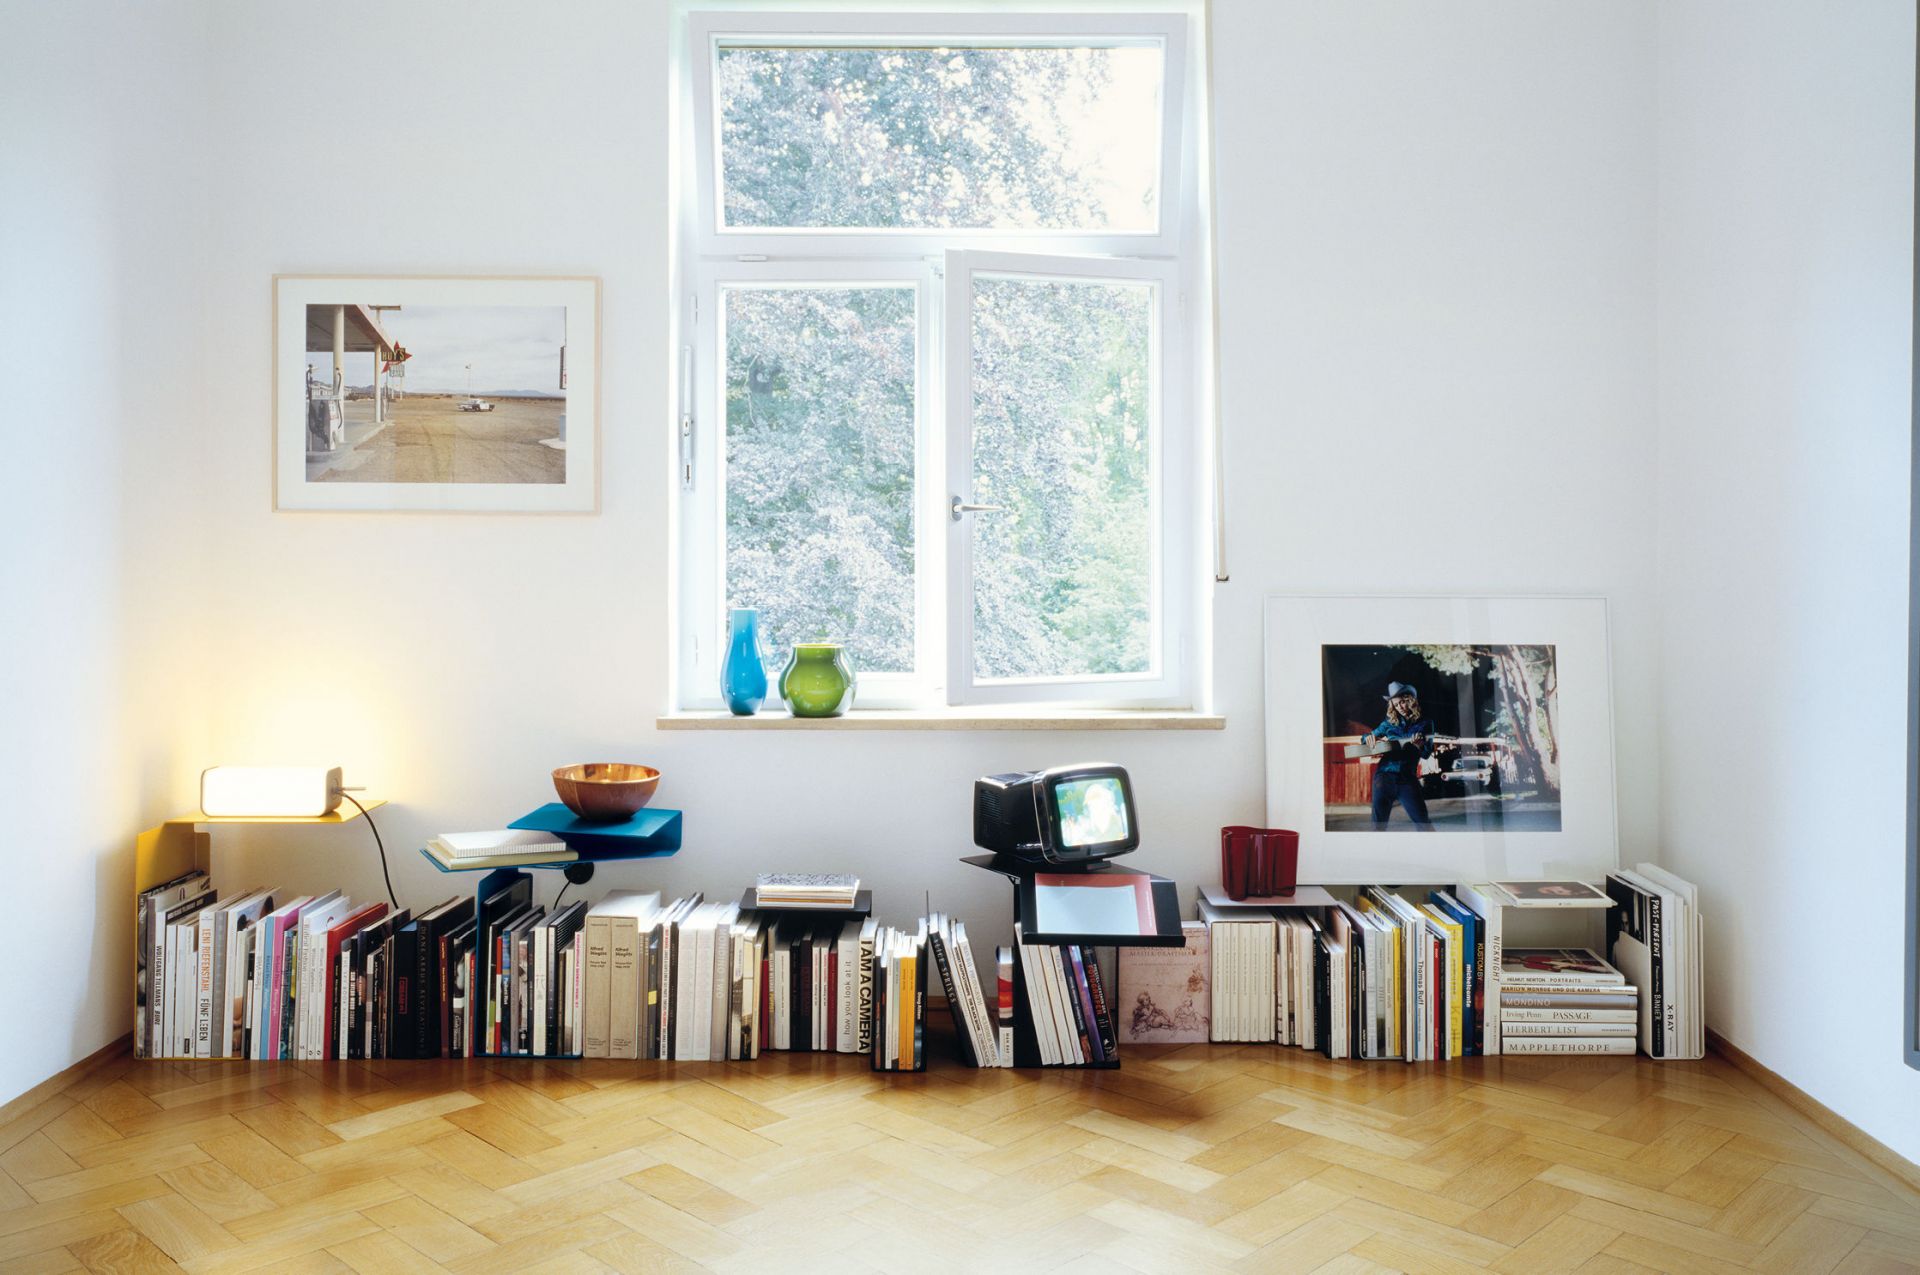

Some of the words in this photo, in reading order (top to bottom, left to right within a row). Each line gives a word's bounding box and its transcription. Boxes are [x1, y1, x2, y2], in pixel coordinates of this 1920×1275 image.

[201, 928, 211, 944] LENI
[1651, 899, 1661, 958] PAST-PRESENT
[860, 947, 872, 972] AM
[200, 946, 211, 992] RIEFENSTAHL
[844, 969, 851, 978] at
[1417, 960, 1425, 989] Thomas
[860, 974, 872, 984] A
[941, 967, 956, 1004] SPRINGS
[154, 978, 162, 1007] TILLMANS
[843, 981, 851, 998] look
[199, 998, 210, 1017] FÜNF
[844, 1001, 854, 1017] you
[1506, 998, 1551, 1007] MONDINO
[859, 986, 872, 1051] CAMERA
[1506, 1011, 1525, 1020] Irving
[1553, 1011, 1592, 1020] PASSAGE
[199, 1018, 209, 1041] LEBEN
[843, 1018, 851, 1035] how
[1507, 1025, 1552, 1034] HERBERT
[1557, 1026, 1577, 1034] LIST
[1508, 1043, 1610, 1052] MAPPLETHORPE
